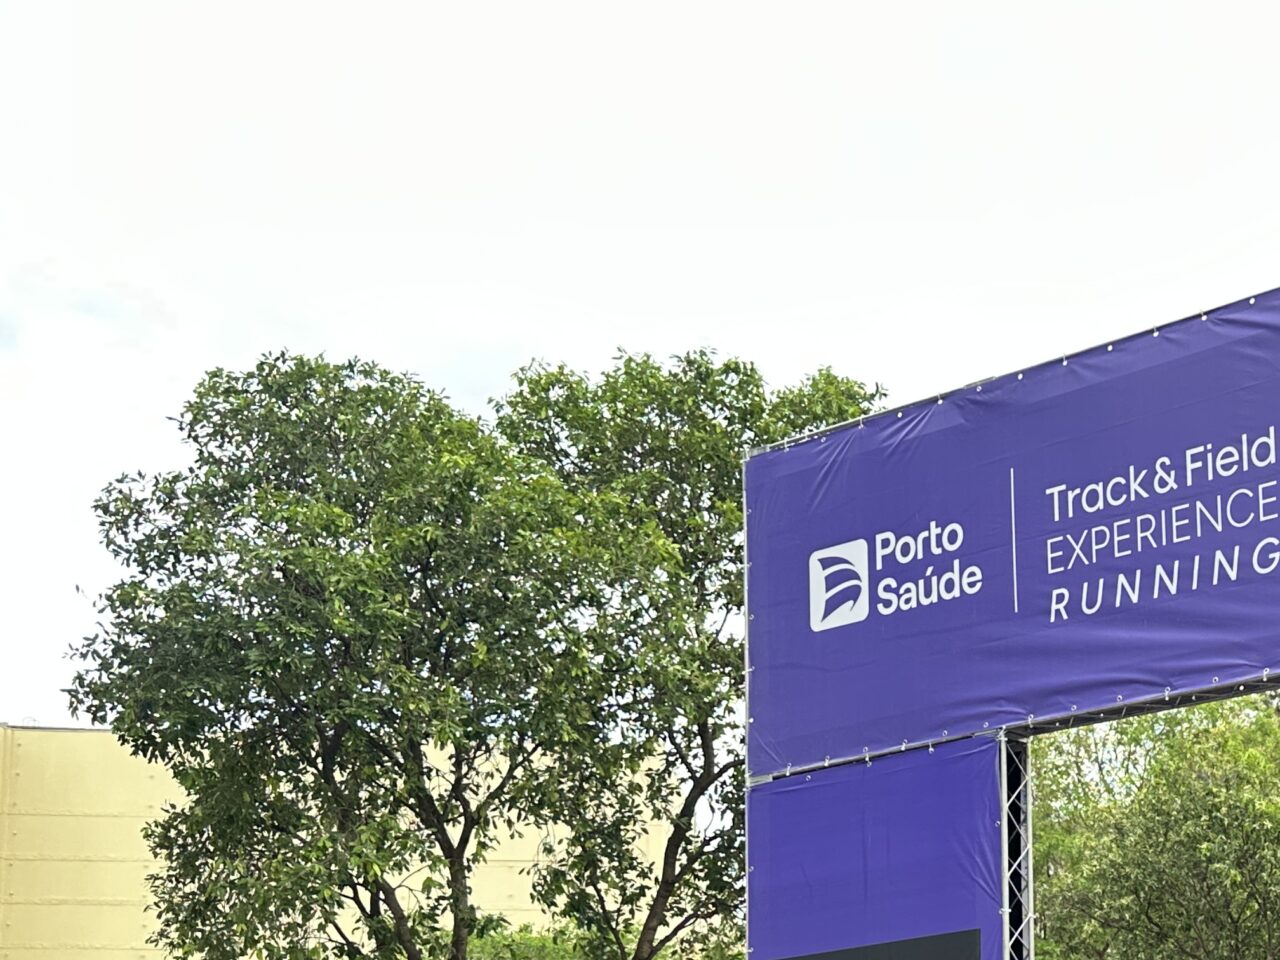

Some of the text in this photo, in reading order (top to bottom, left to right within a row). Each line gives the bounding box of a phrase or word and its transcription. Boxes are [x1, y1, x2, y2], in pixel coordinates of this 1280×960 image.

[1045, 426, 1276, 522] Track & Field
[874, 521, 964, 570] Porto
[1046, 480, 1279, 574] EXPERIENCE
[876, 558, 983, 616] Saúde
